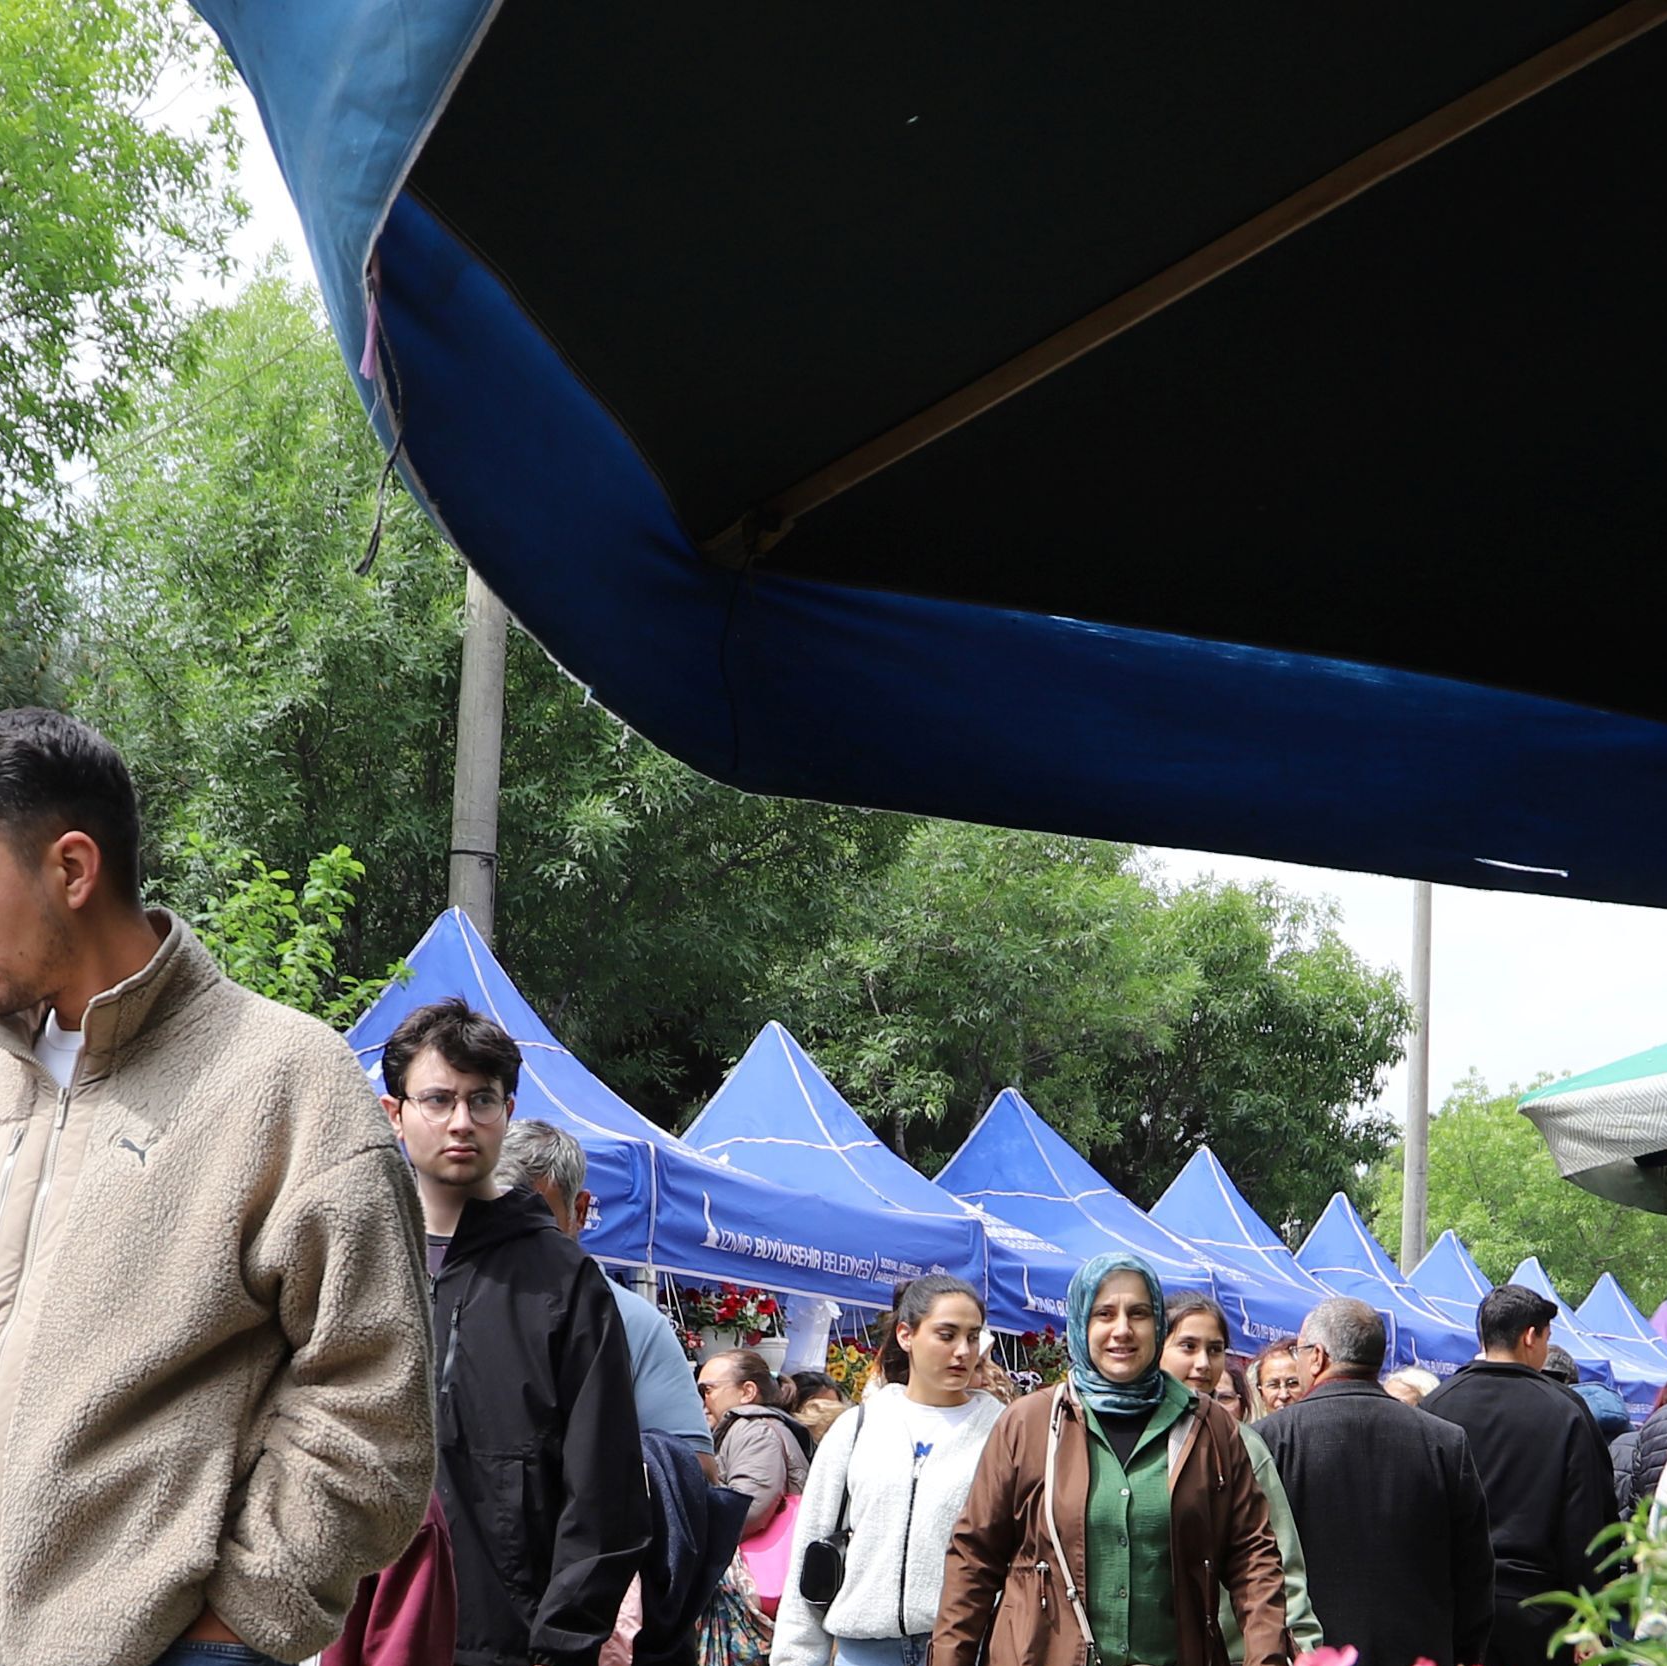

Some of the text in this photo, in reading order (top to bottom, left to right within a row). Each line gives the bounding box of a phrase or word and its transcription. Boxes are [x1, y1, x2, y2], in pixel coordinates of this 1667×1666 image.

[719, 1228, 873, 1281] İZMİR BÜYÜKŞEHİR BELEDİYESİ
